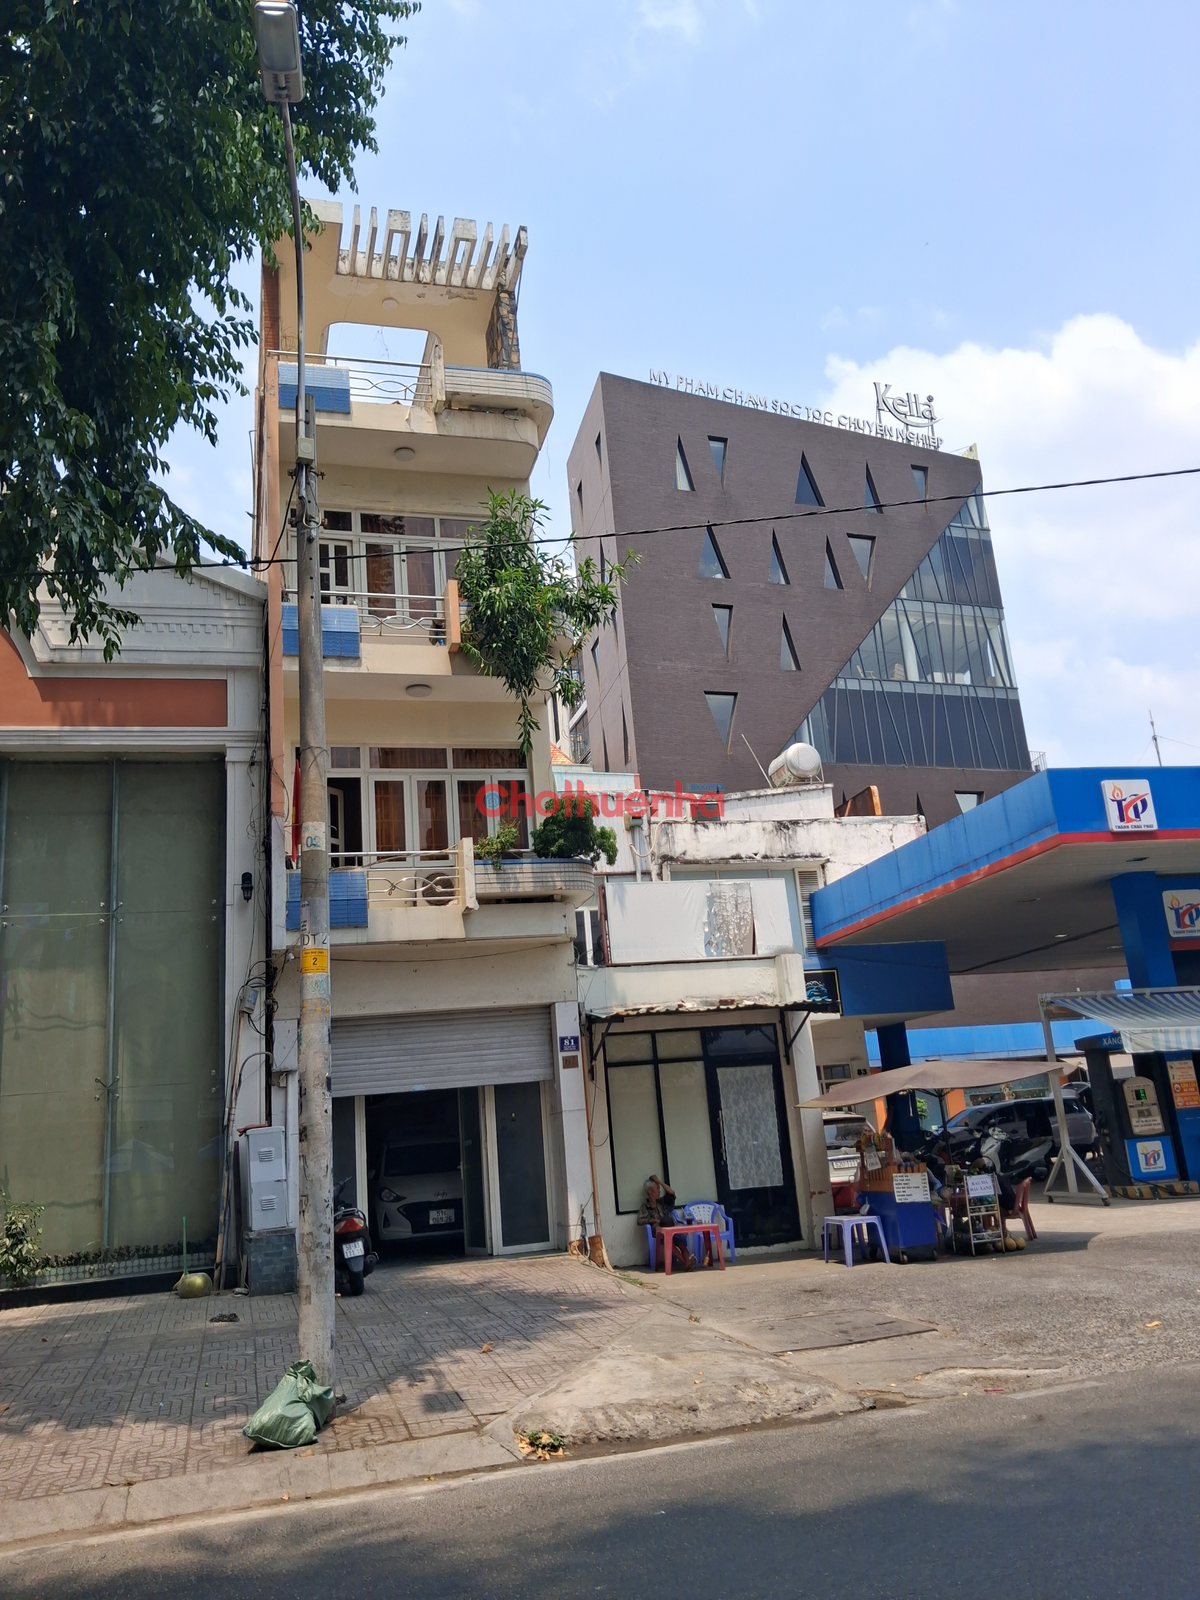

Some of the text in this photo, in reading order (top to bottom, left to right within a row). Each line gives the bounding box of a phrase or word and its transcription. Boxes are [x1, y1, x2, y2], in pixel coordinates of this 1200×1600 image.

[312, 956, 318, 966] 2
[563, 1038, 575, 1046] 81
[857, 1068, 868, 1076] 83
